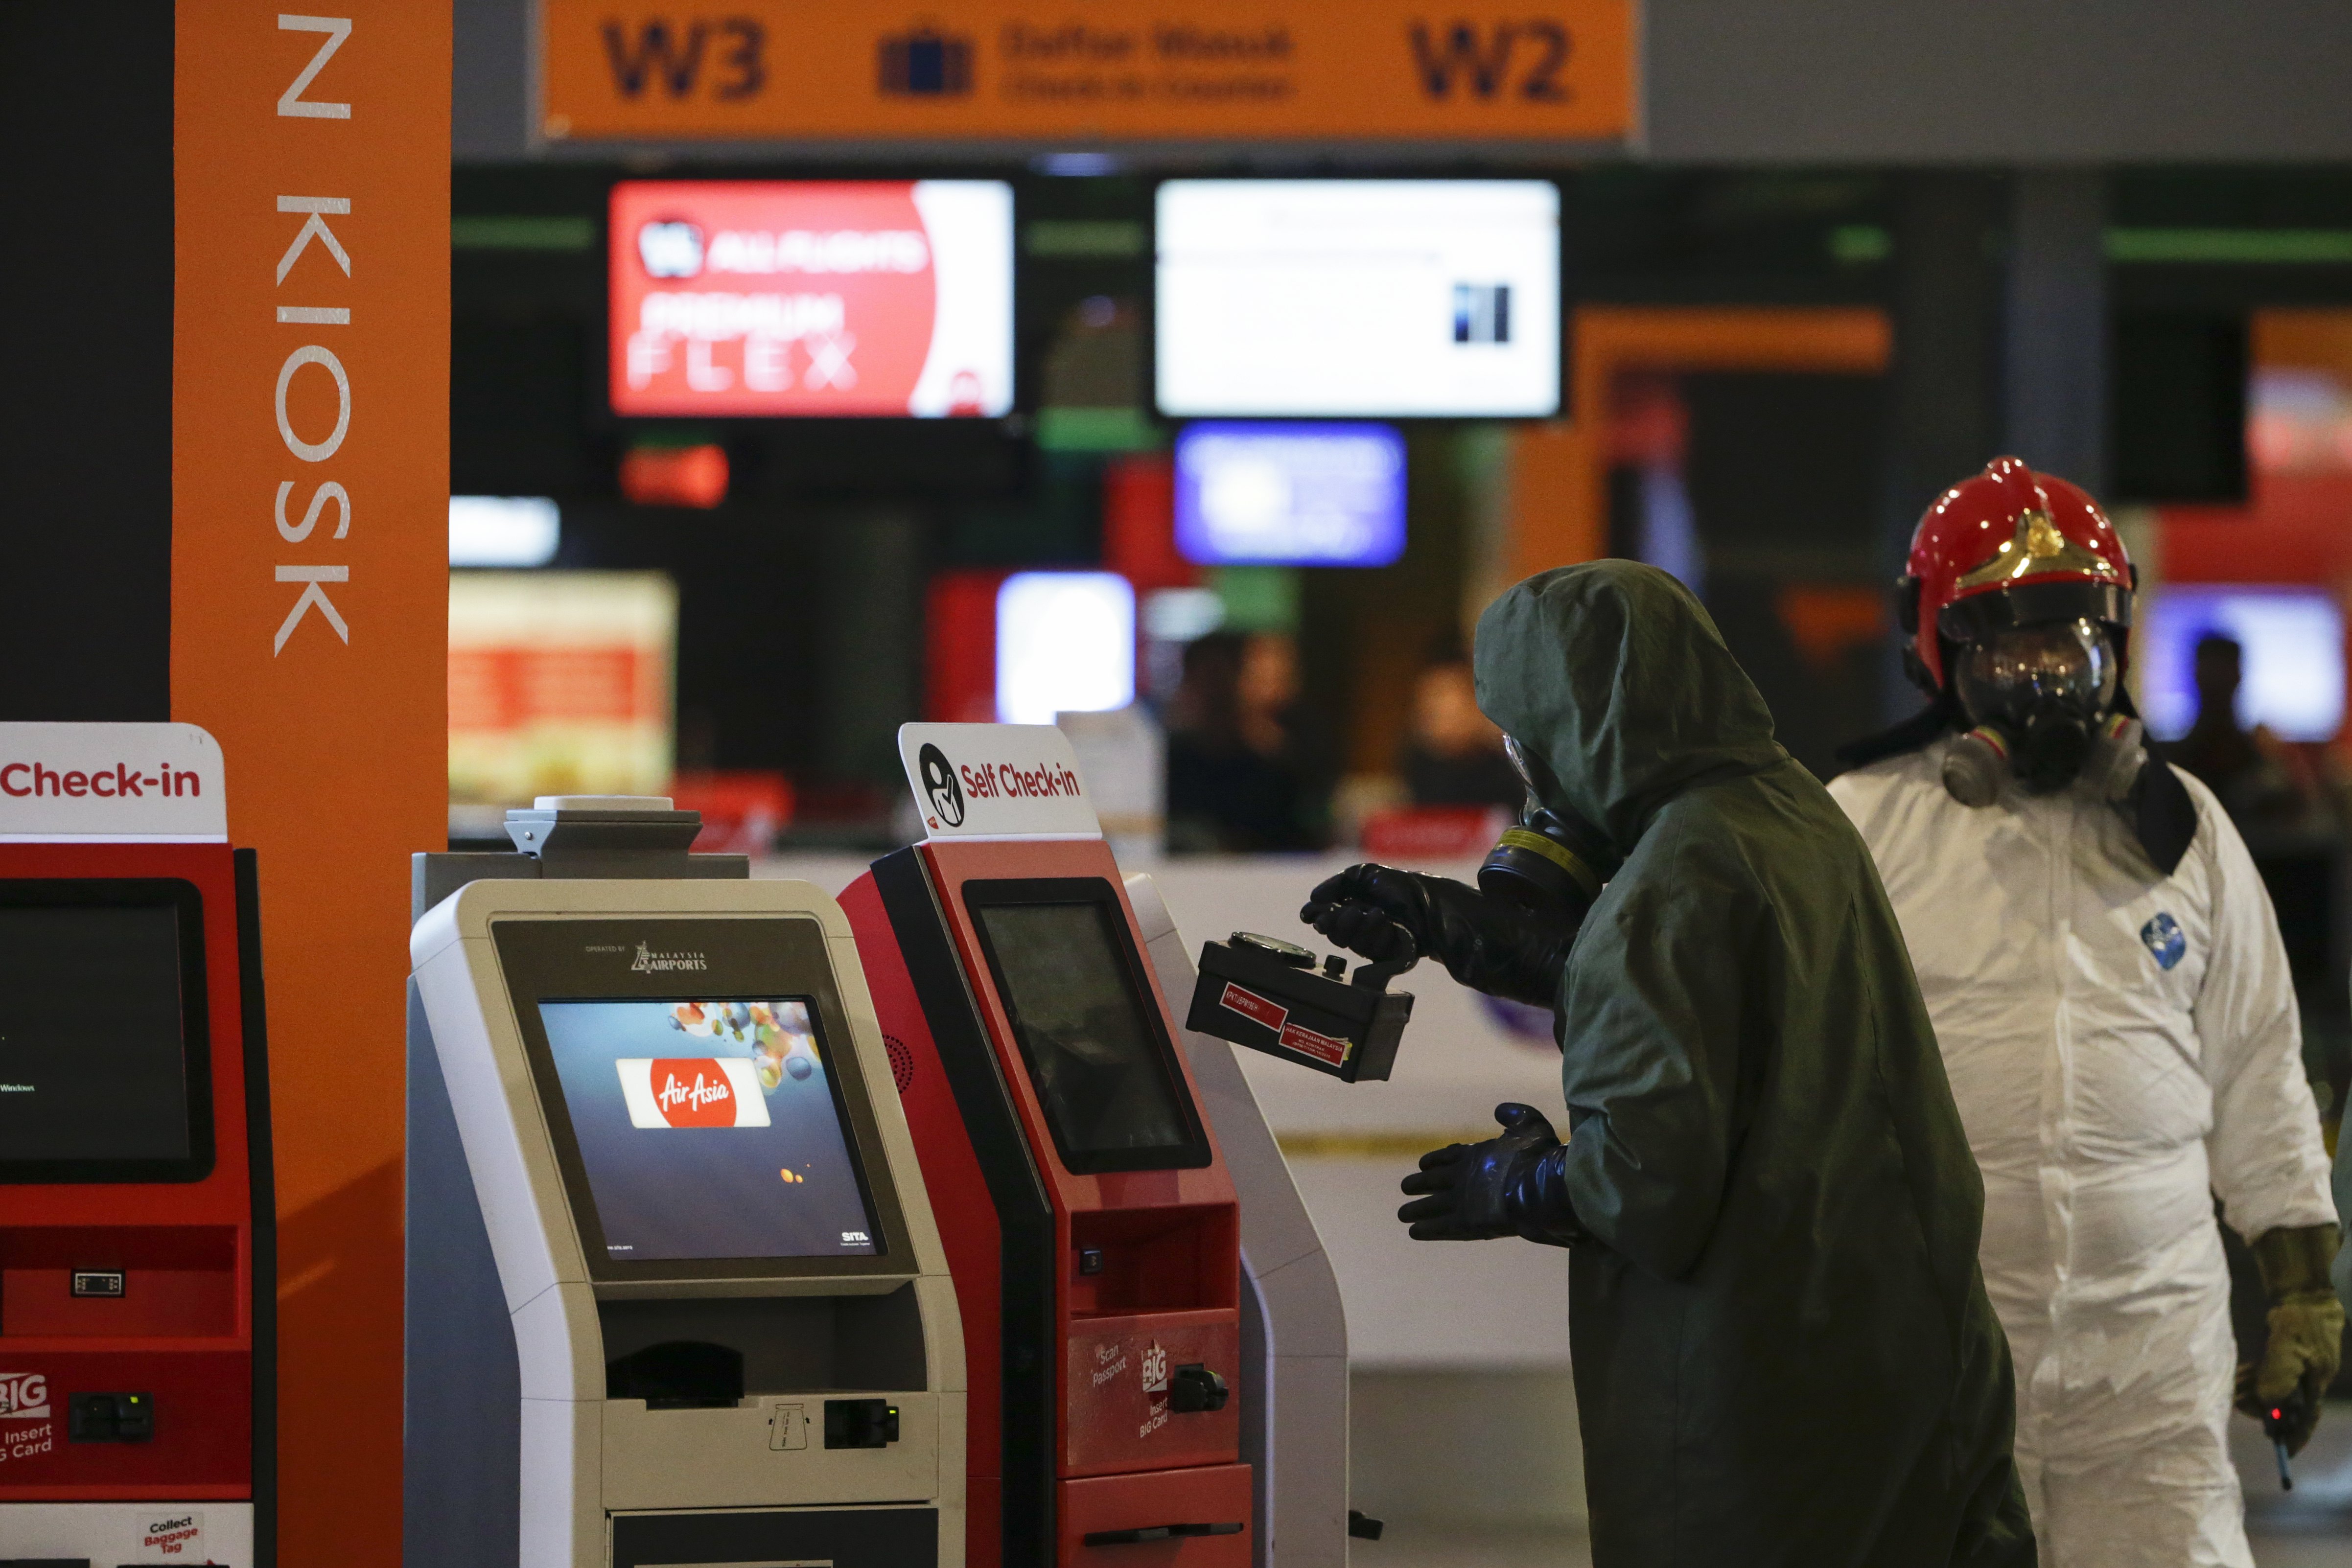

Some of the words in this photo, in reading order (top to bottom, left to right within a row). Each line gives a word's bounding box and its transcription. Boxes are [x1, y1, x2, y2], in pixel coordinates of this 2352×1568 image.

[277, 14, 352, 119] N
[601, 18, 768, 100] W3
[1407, 18, 1574, 102] W2
[628, 331, 858, 392] FLEX
[275, 195, 351, 658] KIOSK
[0, 762, 201, 797] Check-in
[961, 763, 999, 798] Self
[999, 762, 1080, 797] Check-in
[651, 960, 707, 971] AIRPORTS
[1321, 1039, 1343, 1052] MALAYSIA
[0, 1084, 35, 1092] Windows
[841, 1232, 868, 1242] SITA
[1100, 1345, 1119, 1365] Scan
[1093, 1355, 1126, 1388] Passport
[1150, 1396, 1168, 1417] Insert
[5, 1423, 52, 1445] Insert
[1140, 1420, 1151, 1438] BIG
[1152, 1410, 1168, 1430] Card
[12, 1437, 52, 1458] Card
[150, 1516, 192, 1533] Collect
[144, 1528, 198, 1547] Baggage
[161, 1543, 182, 1554] Tag
